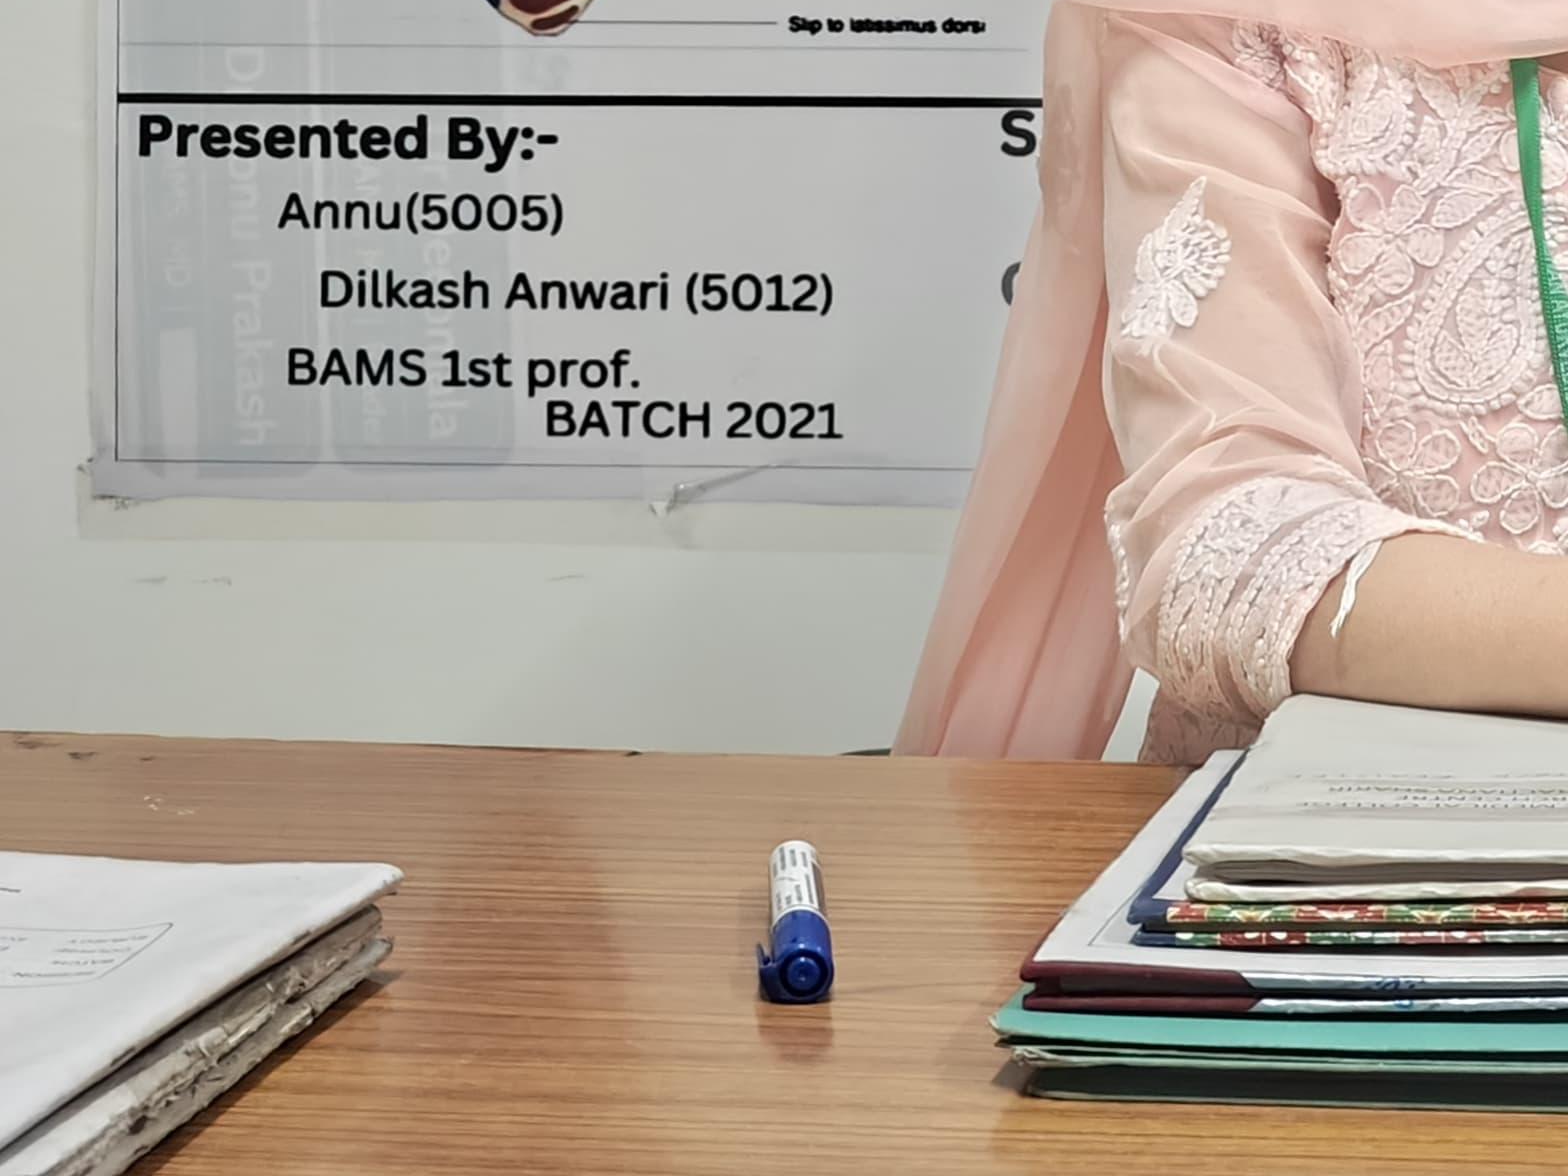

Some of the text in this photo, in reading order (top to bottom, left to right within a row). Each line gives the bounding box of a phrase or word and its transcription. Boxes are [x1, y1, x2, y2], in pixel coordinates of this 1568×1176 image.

[827, 19, 844, 32] to
[139, 115, 558, 173] Presented By:-
[278, 192, 562, 236] Annu(5005)
[321, 269, 832, 316] Dilkash Anwari (5012)
[288, 348, 639, 401] BAMS 1st prof.
[547, 401, 843, 439] BATCH 2021
